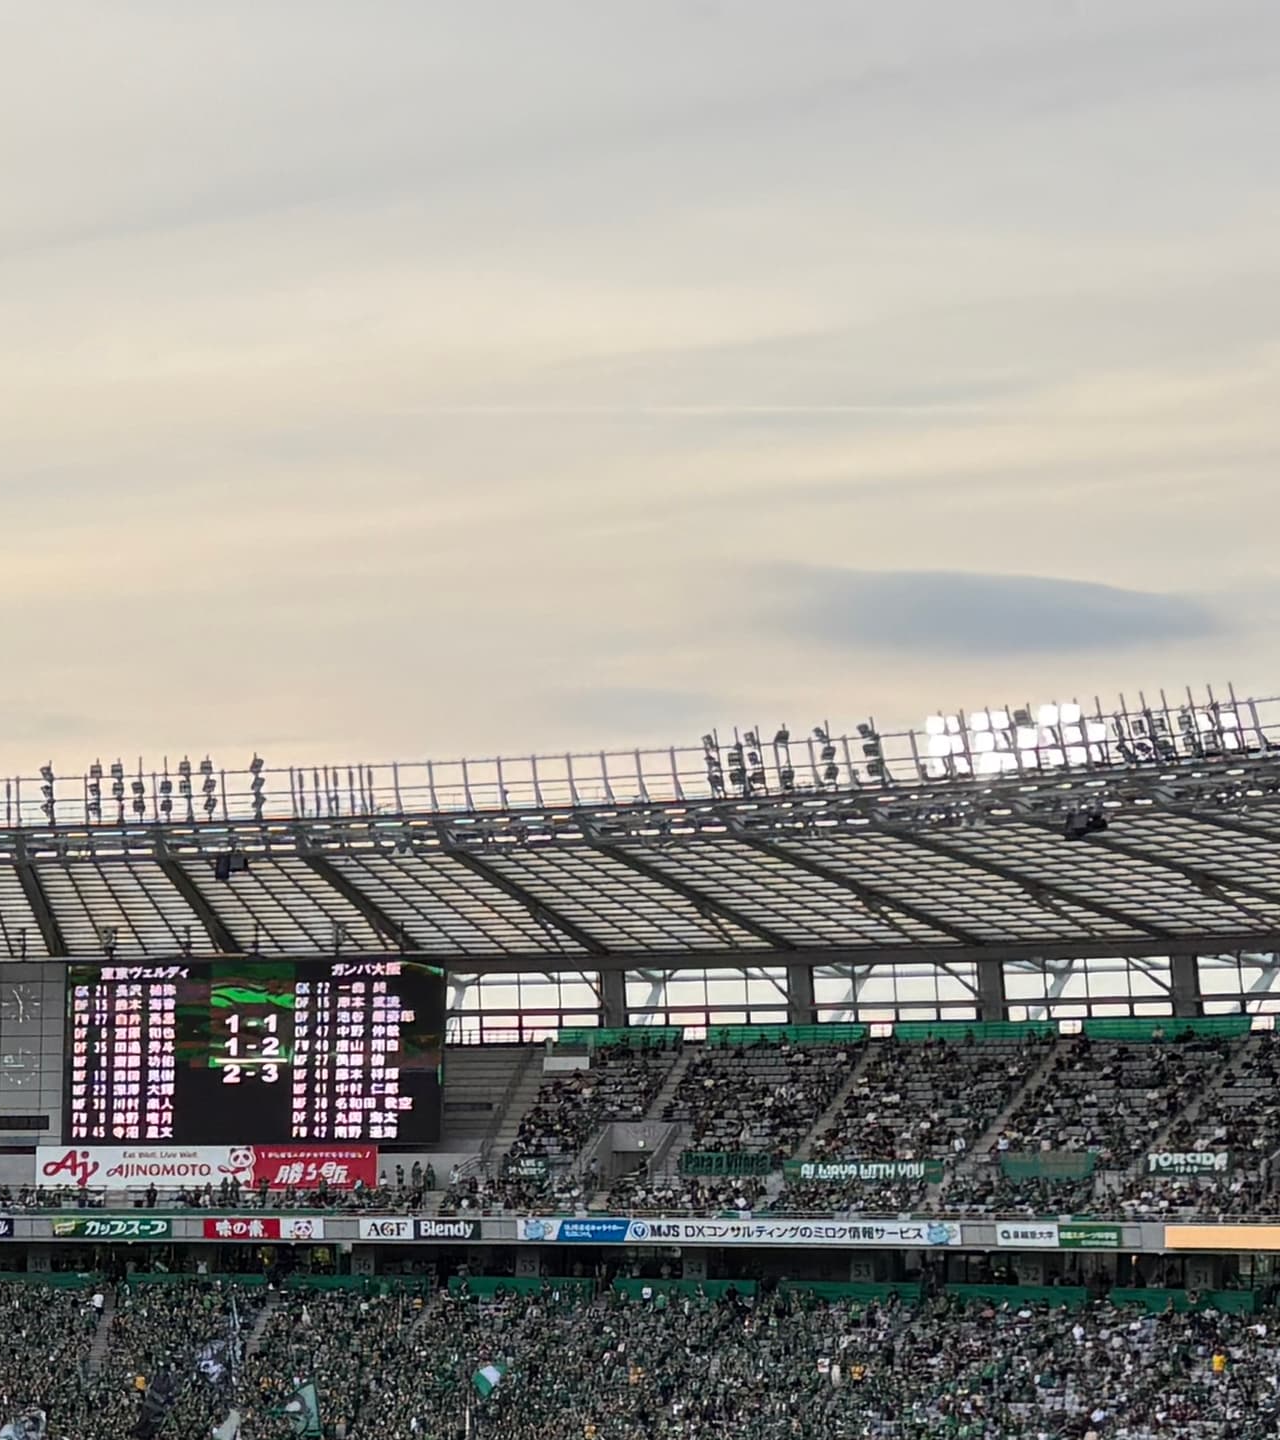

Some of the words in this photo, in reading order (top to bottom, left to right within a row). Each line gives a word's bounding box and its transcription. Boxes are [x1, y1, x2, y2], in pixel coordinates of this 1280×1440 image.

[225, 1014, 239, 1033] 1
[264, 1014, 277, 1033] 1
[224, 1037, 238, 1056] 1
[262, 1036, 279, 1055] 2
[223, 1064, 241, 1083] 2
[261, 1063, 278, 1082] 3
[106, 1163, 211, 1178] AJINOMOTO
[860, 1163, 895, 1179] WITH
[898, 1163, 925, 1179] YOU
[85, 1220, 167, 1235] カップスープ
[367, 1222, 408, 1237] AGF
[420, 1221, 474, 1239] Blendy
[650, 1225, 680, 1237] MJS
